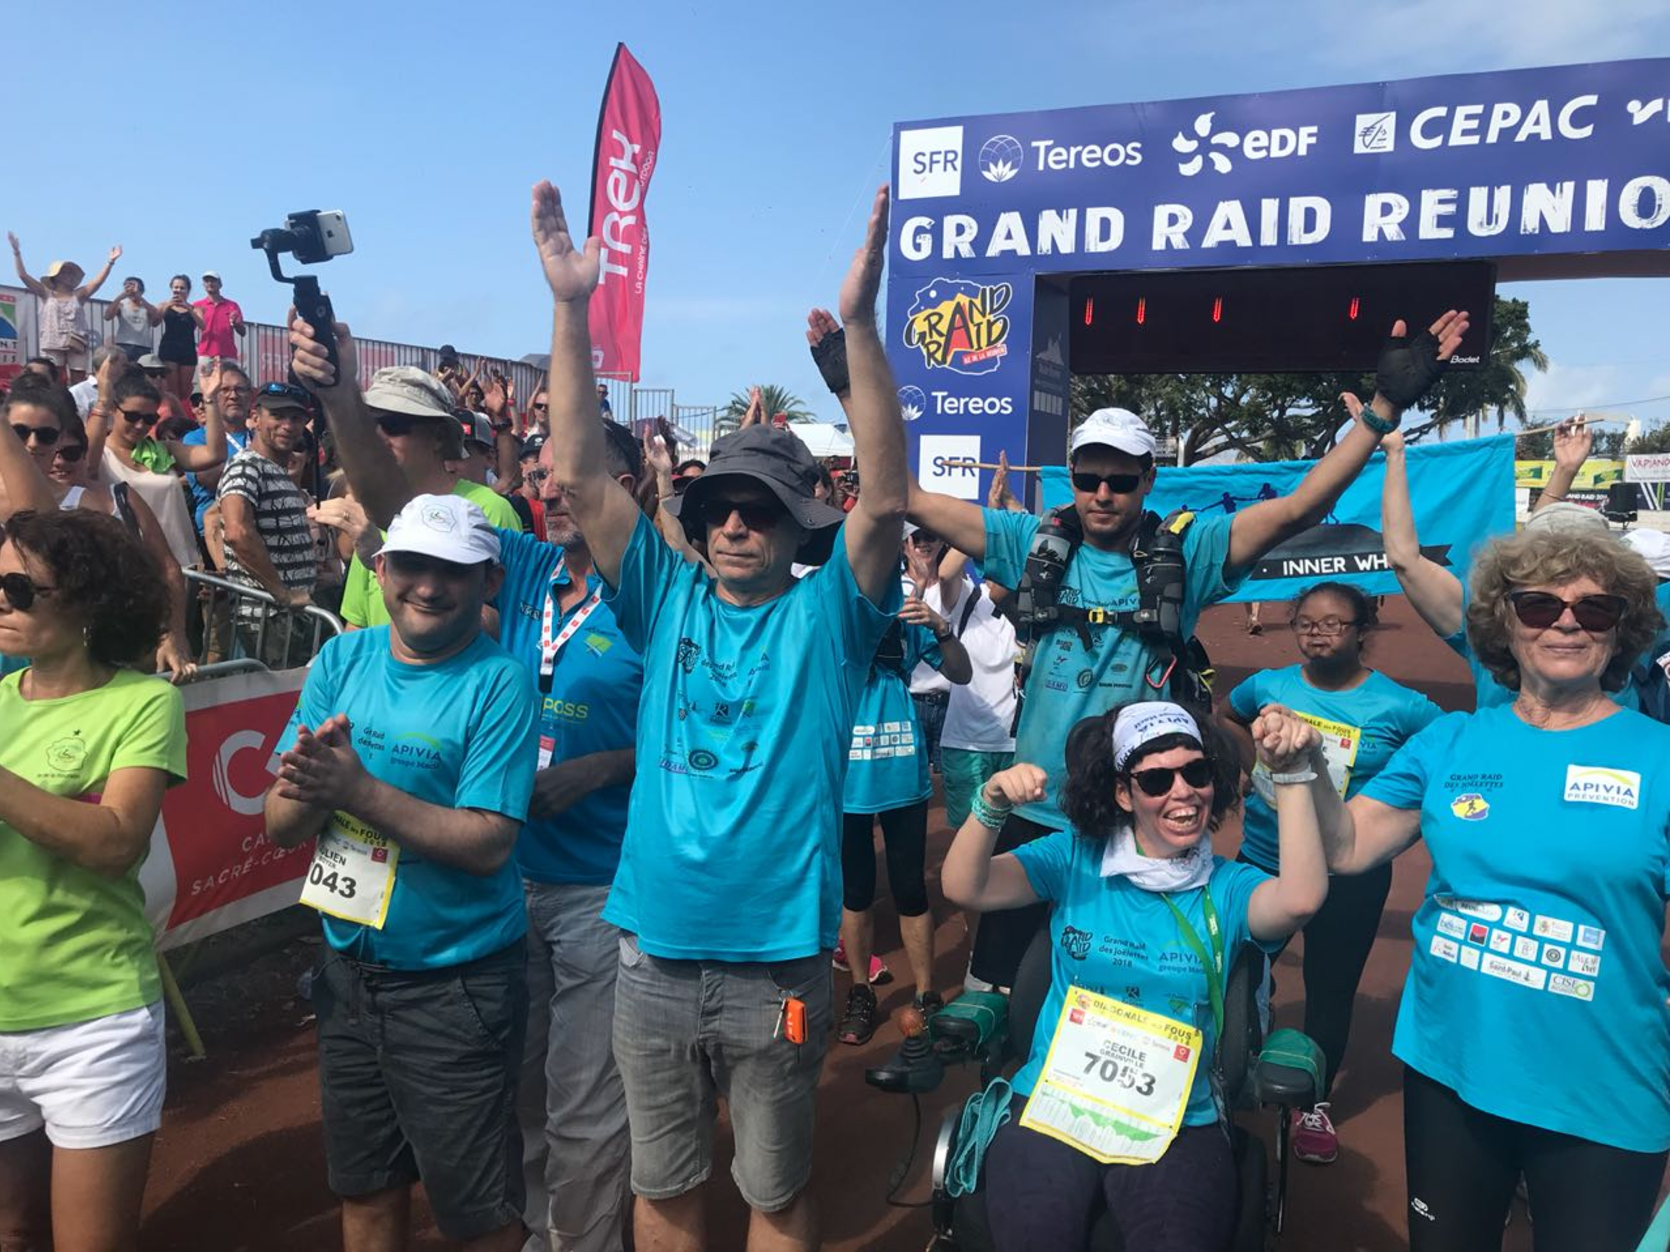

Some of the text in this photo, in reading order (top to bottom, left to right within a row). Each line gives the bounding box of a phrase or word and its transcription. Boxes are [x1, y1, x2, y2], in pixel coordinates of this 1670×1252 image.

[1409, 95, 1598, 149] CEPAC
[913, 150, 959, 175] SFR
[1031, 140, 1143, 171] Tereos
[900, 206, 1125, 262] GRAND
[1152, 196, 1332, 251] RAID
[905, 283, 1011, 348] GRAND
[1450, 355, 1480, 364] Bodet
[931, 391, 1013, 415] Tereos
[932, 456, 977, 477] SFR
[1282, 553, 1389, 576] INNER WH
[392, 744, 442, 761] APIVIA
[1569, 782, 1635, 798] APIVIA
[242, 834, 271, 852] CA
[309, 861, 357, 899] 043
[1099, 945, 1113, 954] des
[1103, 935, 1129, 946] Grand
[1112, 957, 1133, 968] 2018
[1164, 1024, 1193, 1041] FOUS
[1103, 1039, 1148, 1063] CECILE
[1083, 1051, 1157, 1097] 7053
